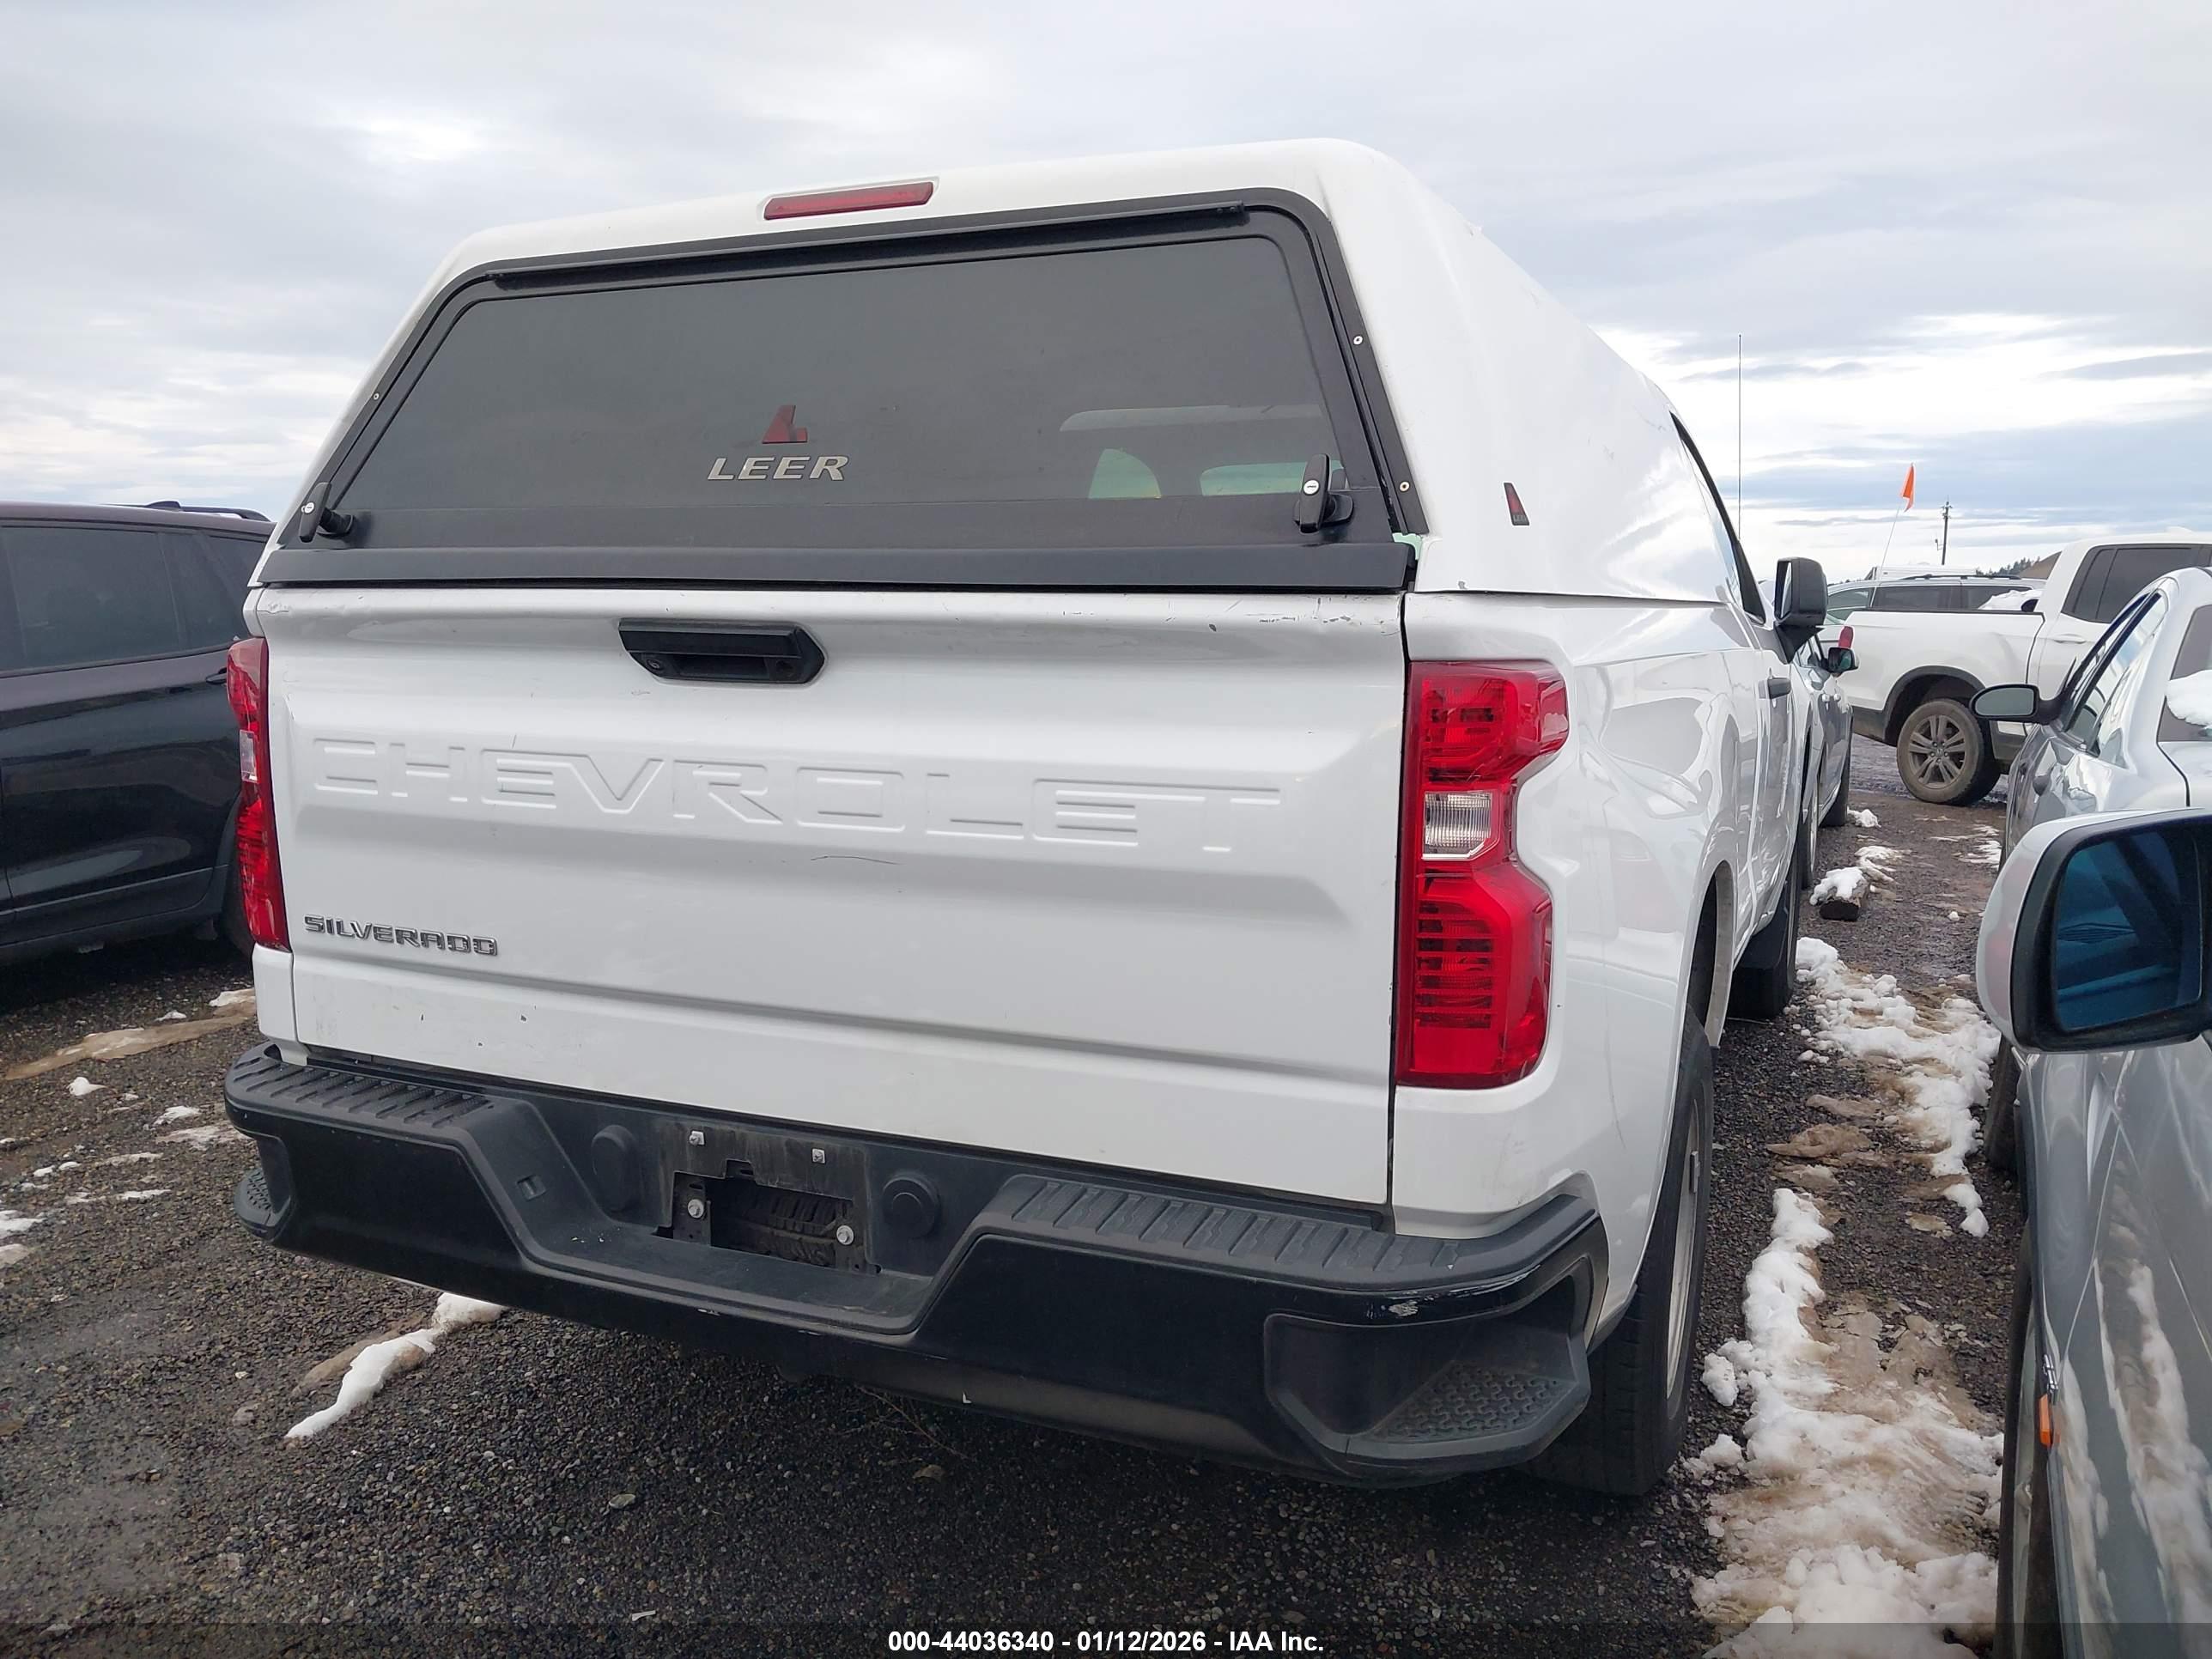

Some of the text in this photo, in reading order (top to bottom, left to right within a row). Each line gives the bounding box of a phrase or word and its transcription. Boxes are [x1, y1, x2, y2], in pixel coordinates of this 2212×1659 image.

[707, 455, 849, 481] LEER
[313, 737, 1281, 852] CHEVROLET
[303, 914, 499, 957] SILVERADO
